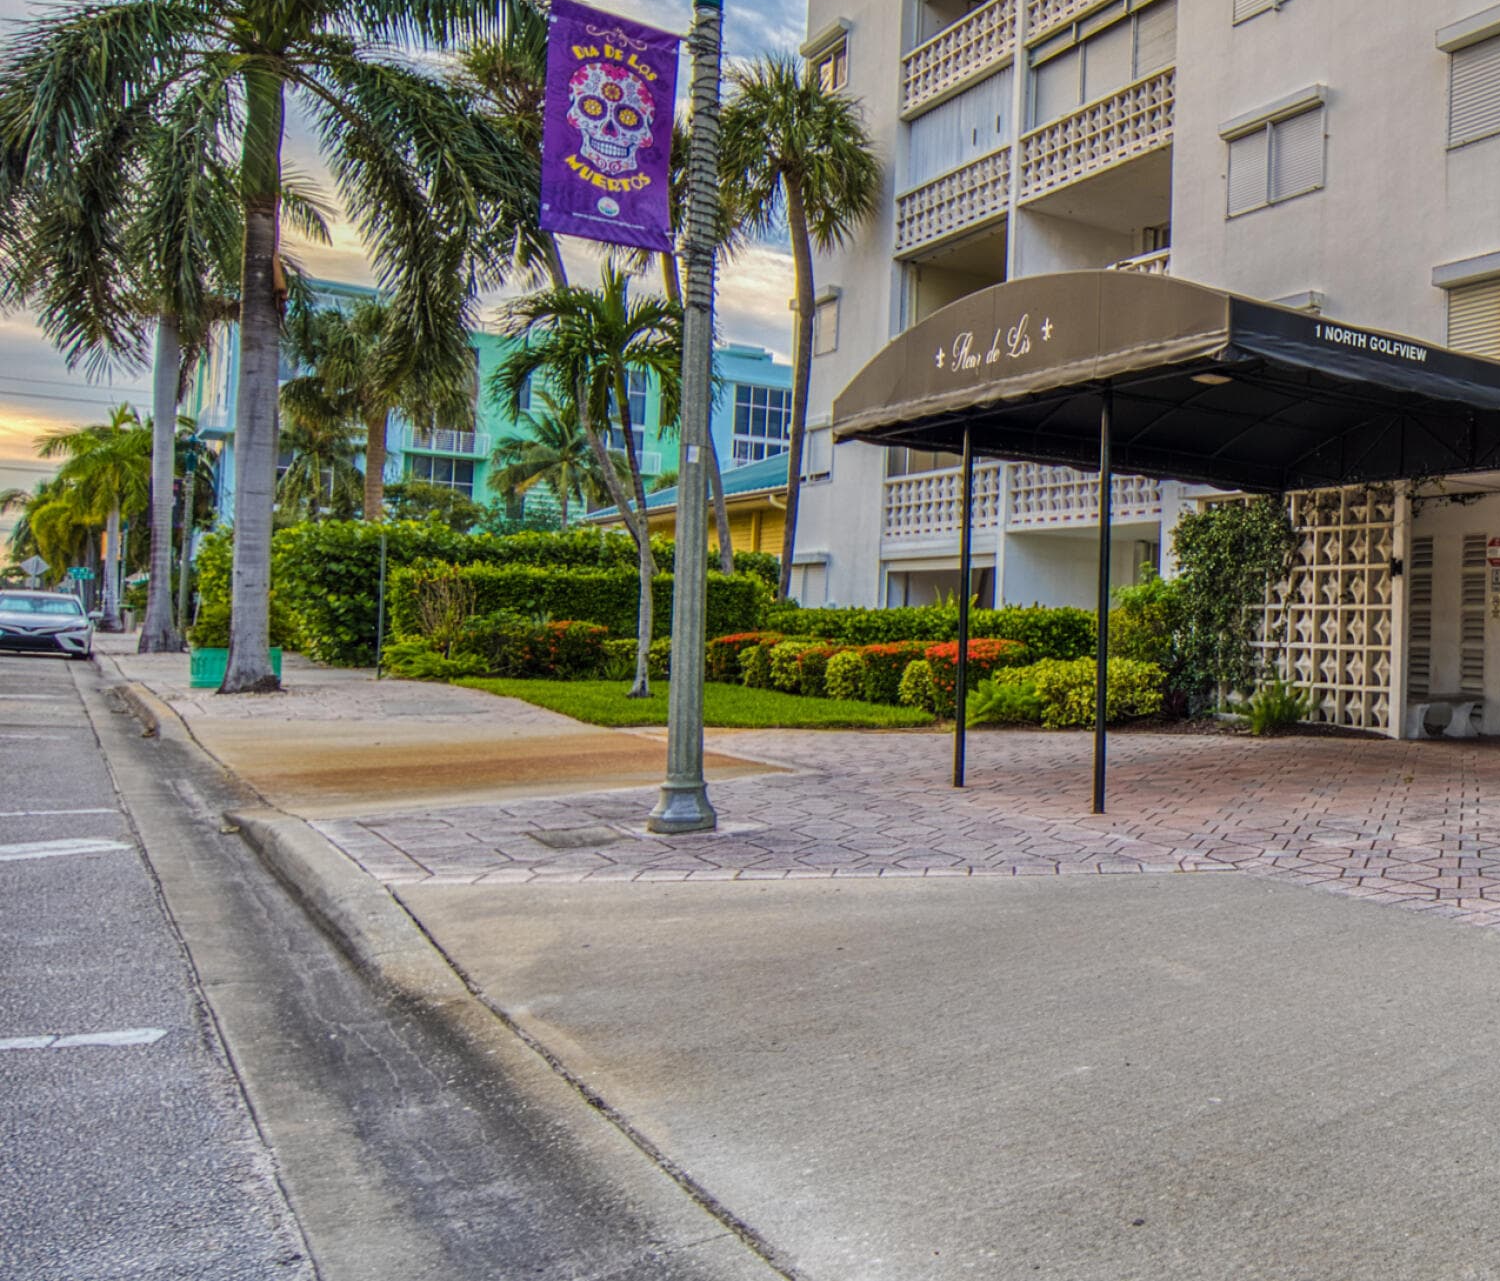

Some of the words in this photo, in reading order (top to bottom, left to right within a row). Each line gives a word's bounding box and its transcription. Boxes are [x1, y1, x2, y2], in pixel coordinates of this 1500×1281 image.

[604, 43, 624, 62] DE
[627, 53, 658, 81] LOS
[564, 154, 652, 193] MUERTOS
[986, 328, 1001, 365] de
[1006, 313, 1031, 358] Lis
[1315, 324, 1321, 339] 1
[1325, 326, 1366, 349] NORTH
[1369, 336, 1427, 362] GOLFVIEW
